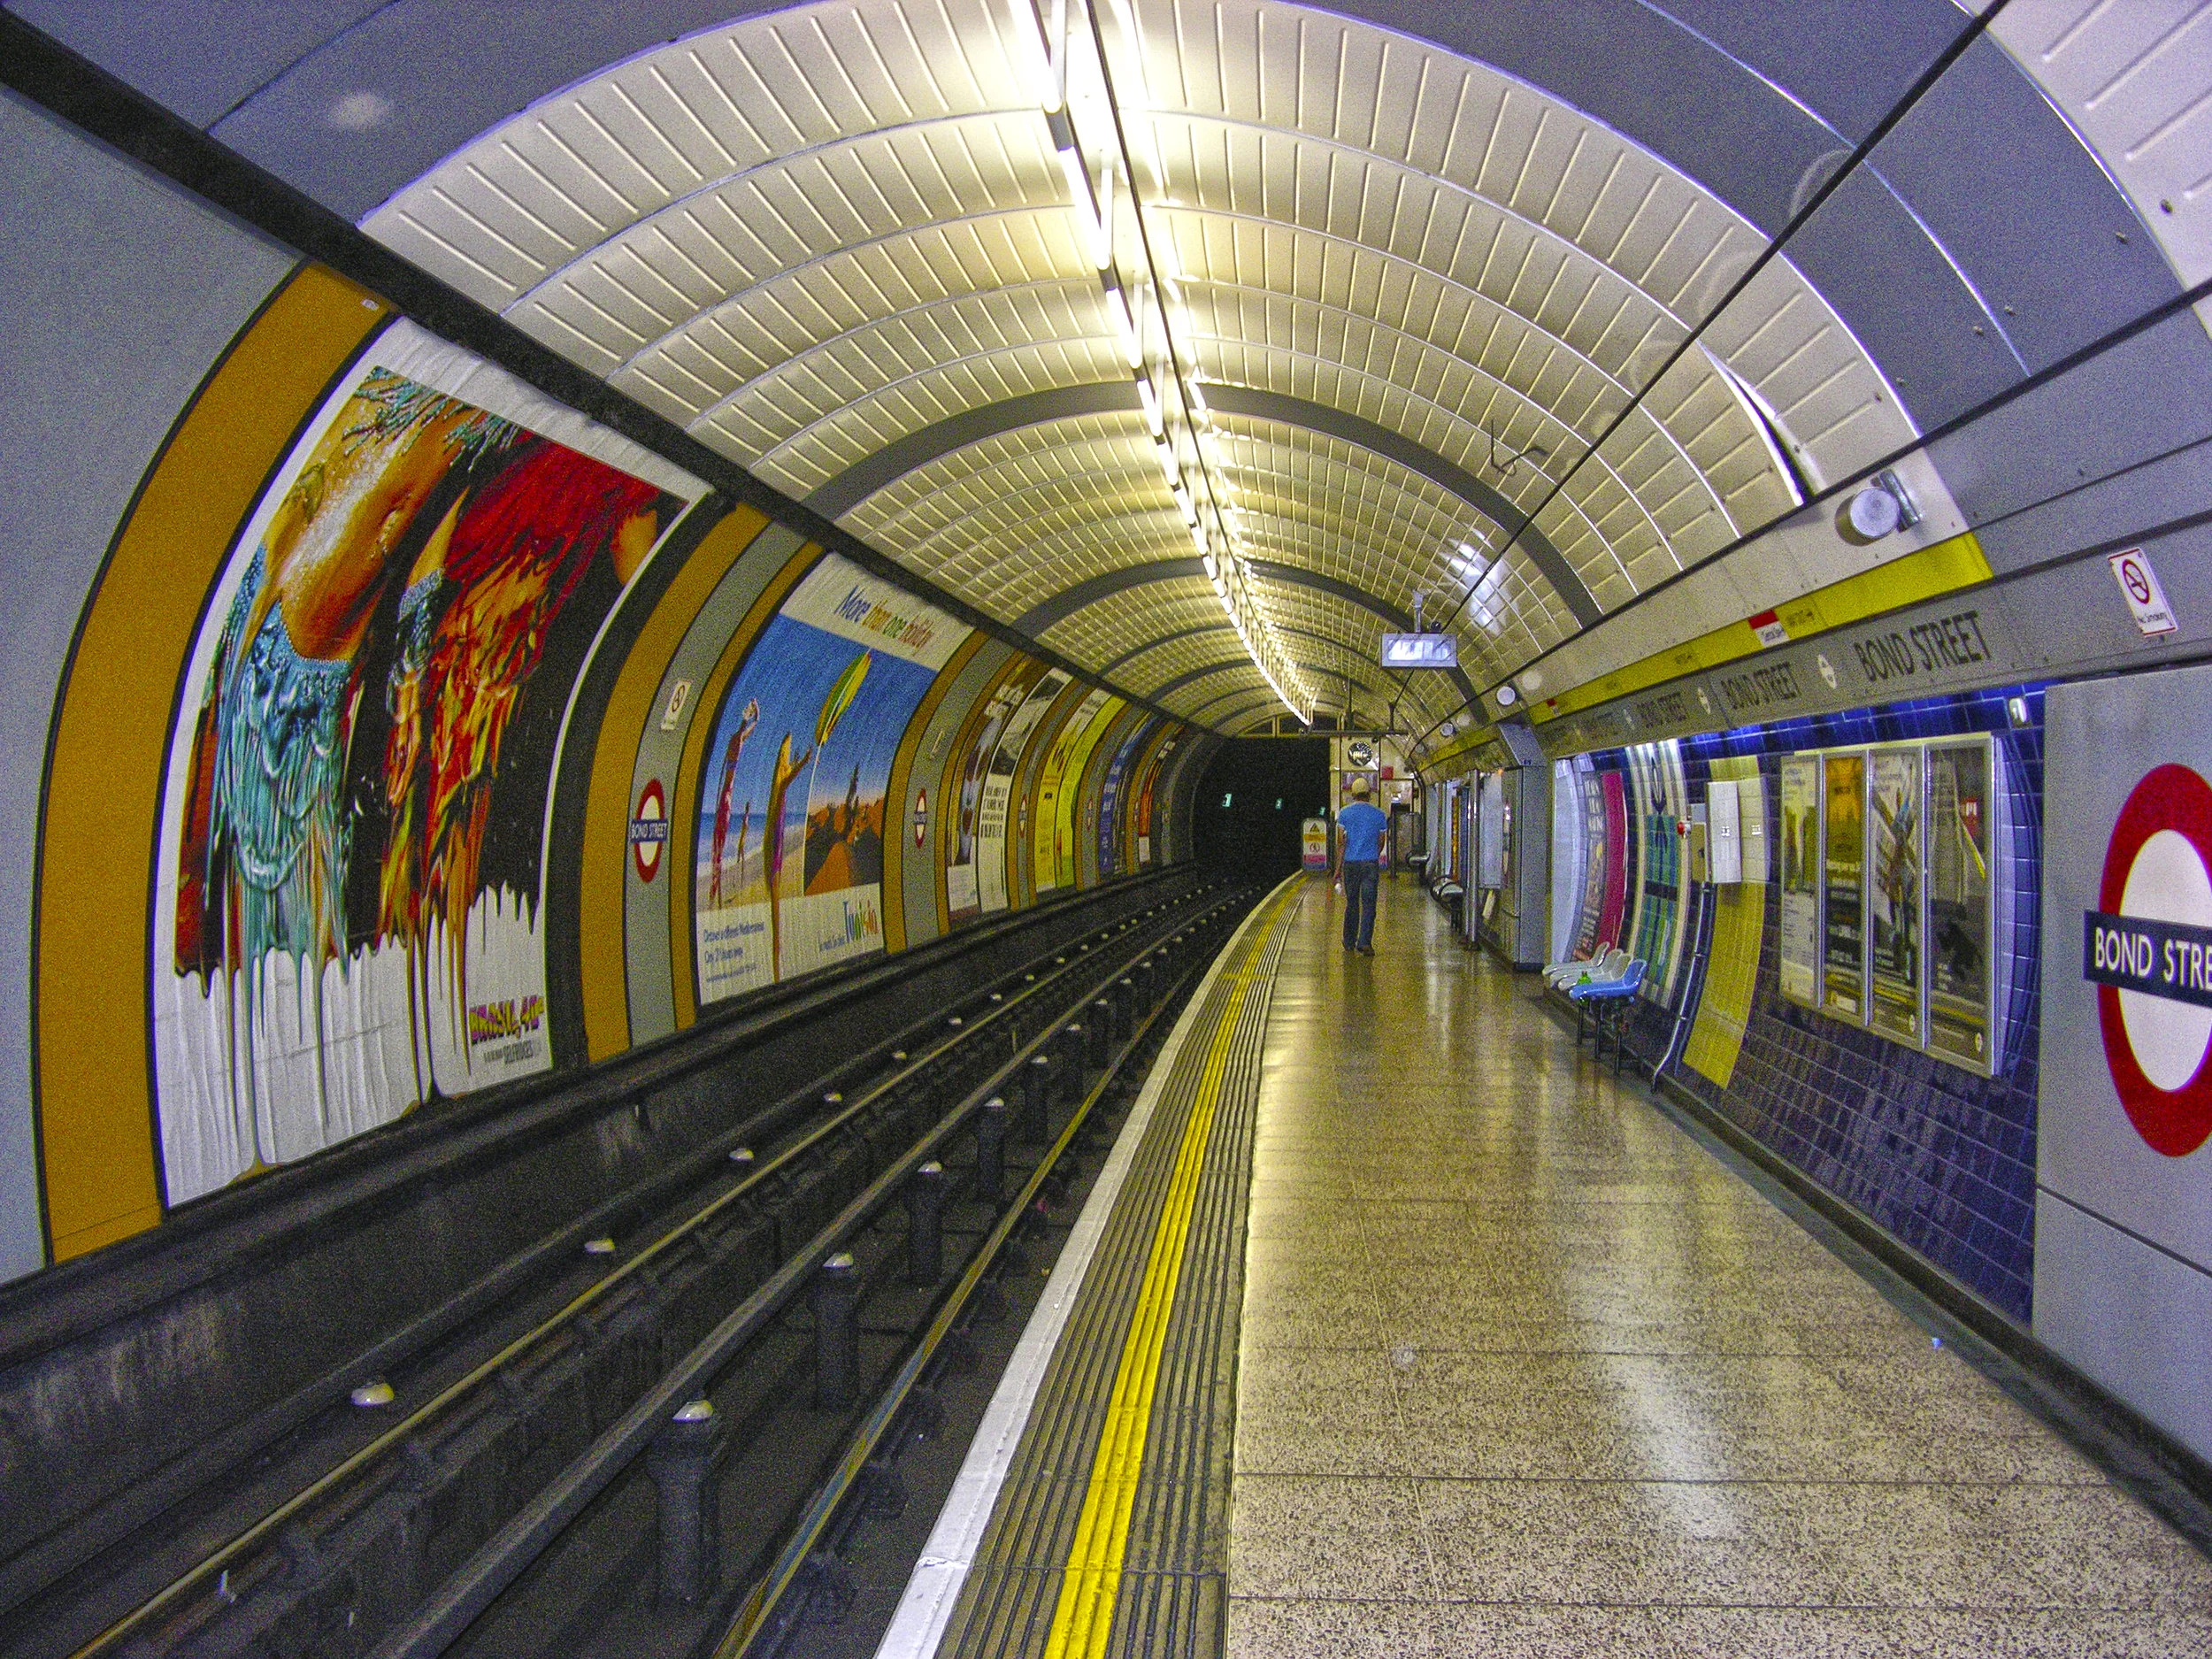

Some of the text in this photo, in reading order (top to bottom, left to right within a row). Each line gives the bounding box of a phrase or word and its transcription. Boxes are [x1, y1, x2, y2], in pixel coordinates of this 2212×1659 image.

[834, 585, 872, 623] More
[1854, 610, 1991, 681] BOND STREET
[631, 822, 668, 839] BOND STREET
[2094, 926, 2212, 992] BOND STRE
